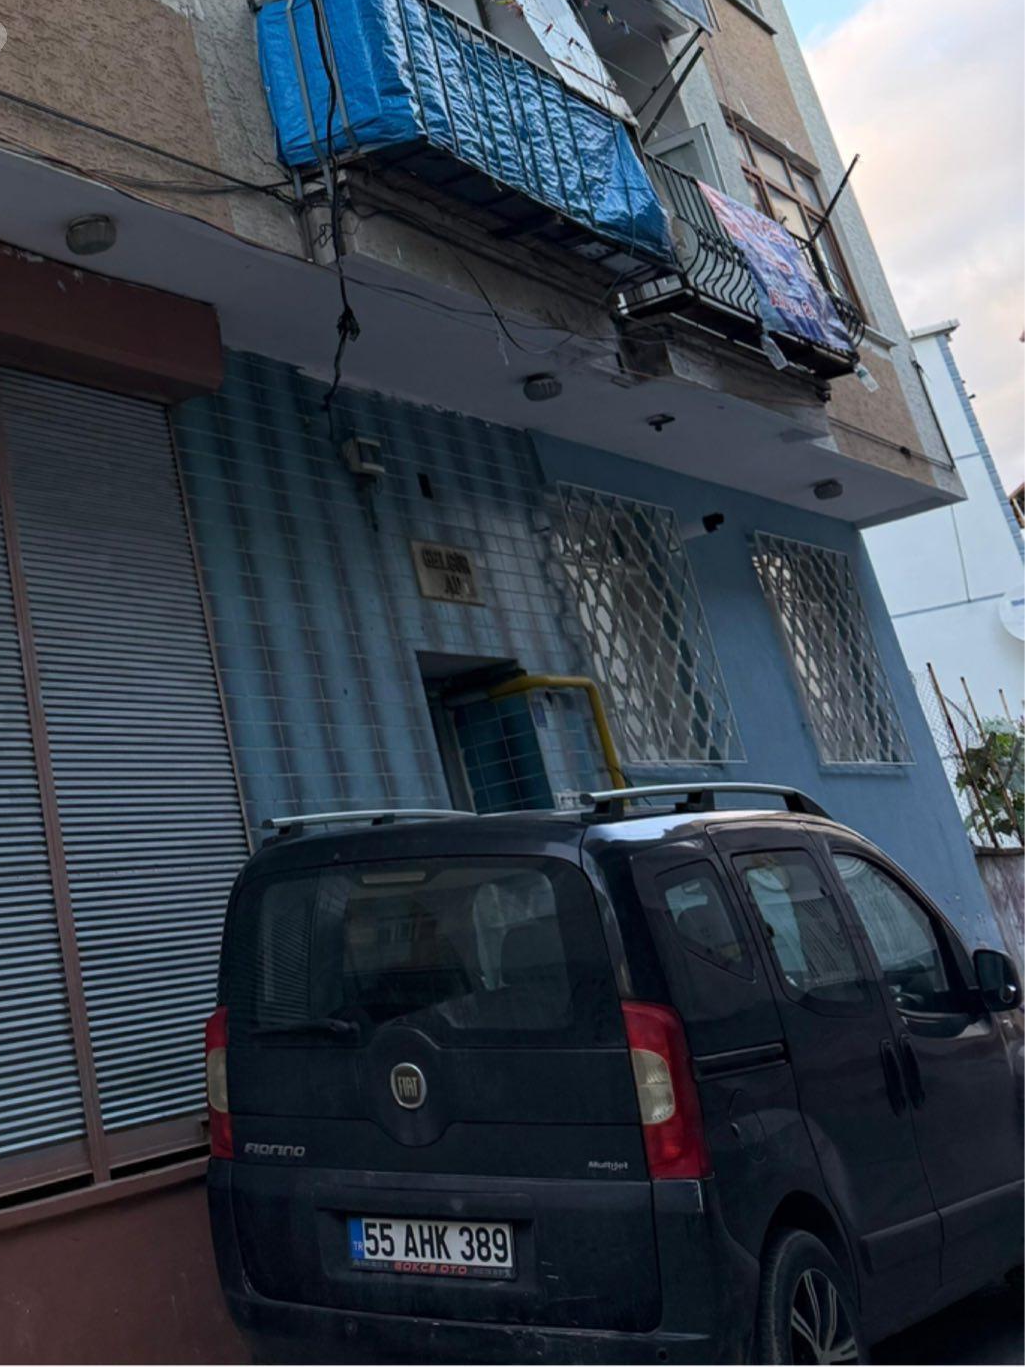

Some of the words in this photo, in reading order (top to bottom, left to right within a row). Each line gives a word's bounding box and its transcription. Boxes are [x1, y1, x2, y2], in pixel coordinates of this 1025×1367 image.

[397, 1076, 418, 1098] FIAT
[364, 1222, 395, 1257] 55
[404, 1224, 451, 1260] AHK
[458, 1226, 509, 1263] 389
